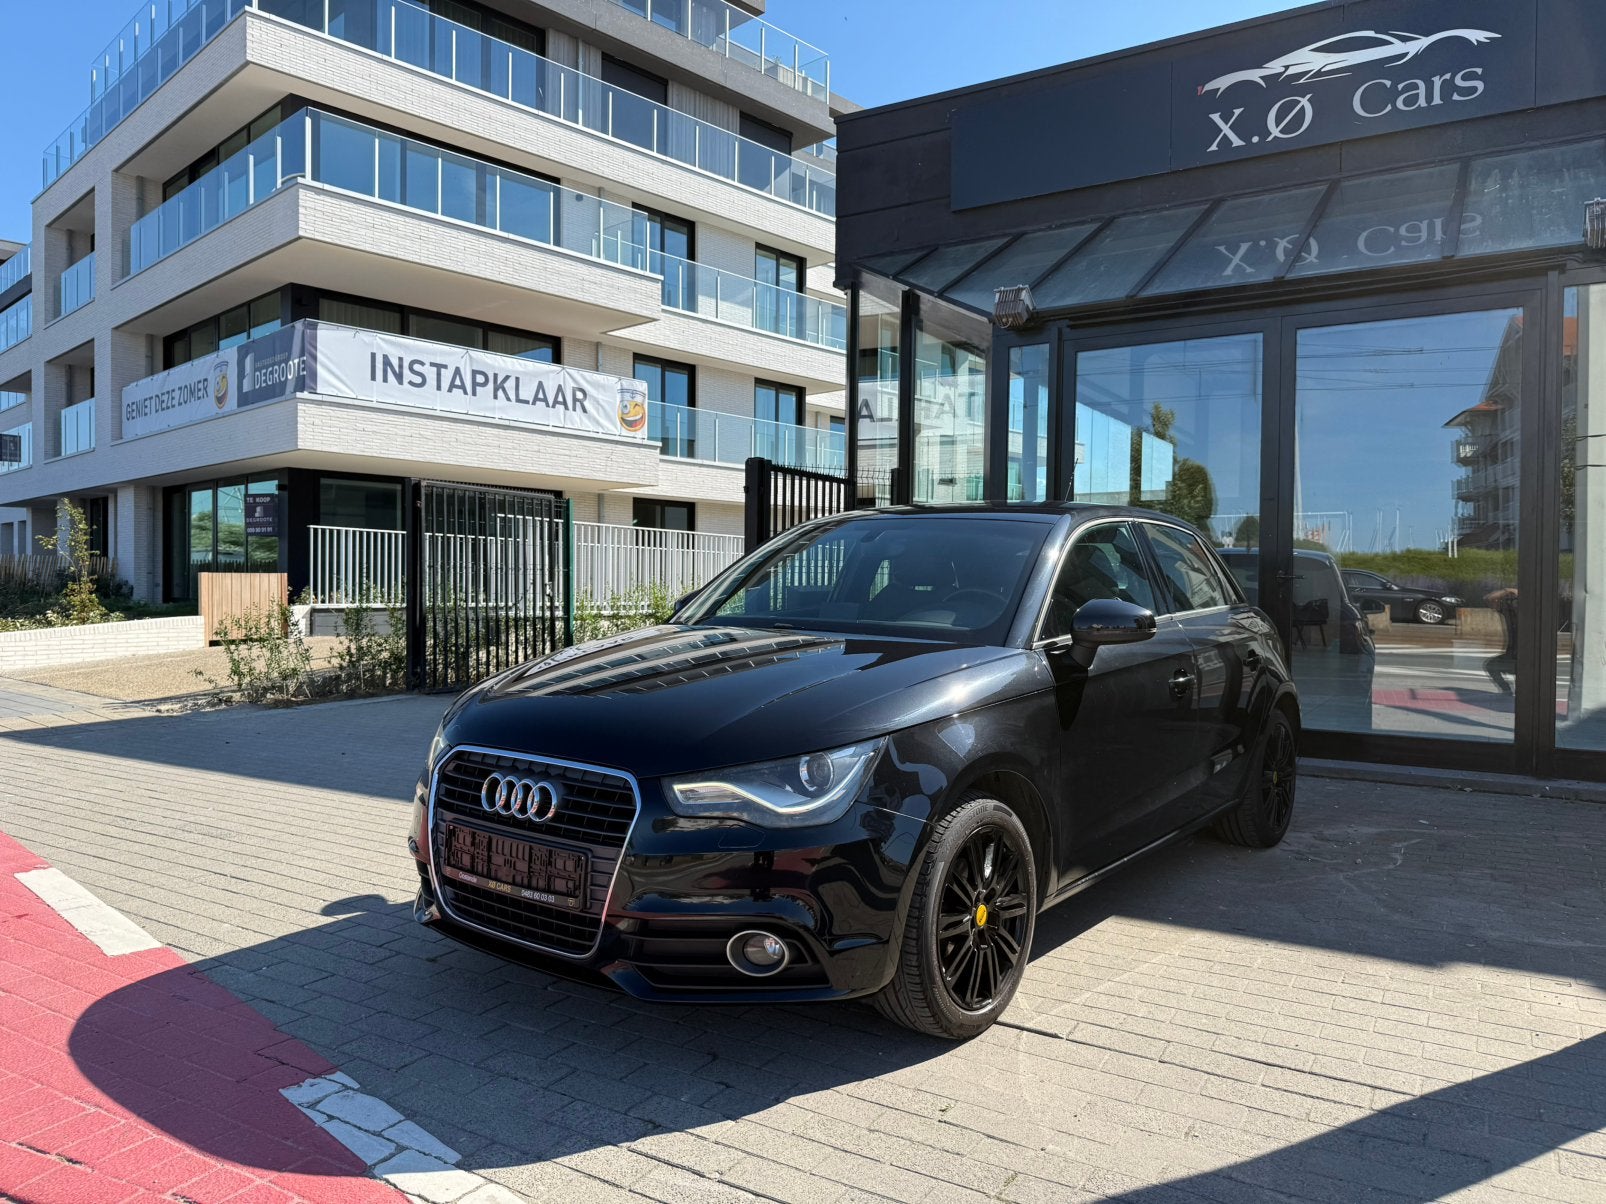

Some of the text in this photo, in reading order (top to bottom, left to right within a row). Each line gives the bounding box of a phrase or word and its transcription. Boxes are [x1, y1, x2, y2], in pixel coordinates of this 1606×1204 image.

[1352, 67, 1486, 118] Cars
[255, 356, 307, 390] DEGROOTE
[370, 352, 589, 414] INSTAPKLAAR
[125, 378, 209, 422] GENIET DEZE ZOMER
[496, 882, 511, 892] CARS
